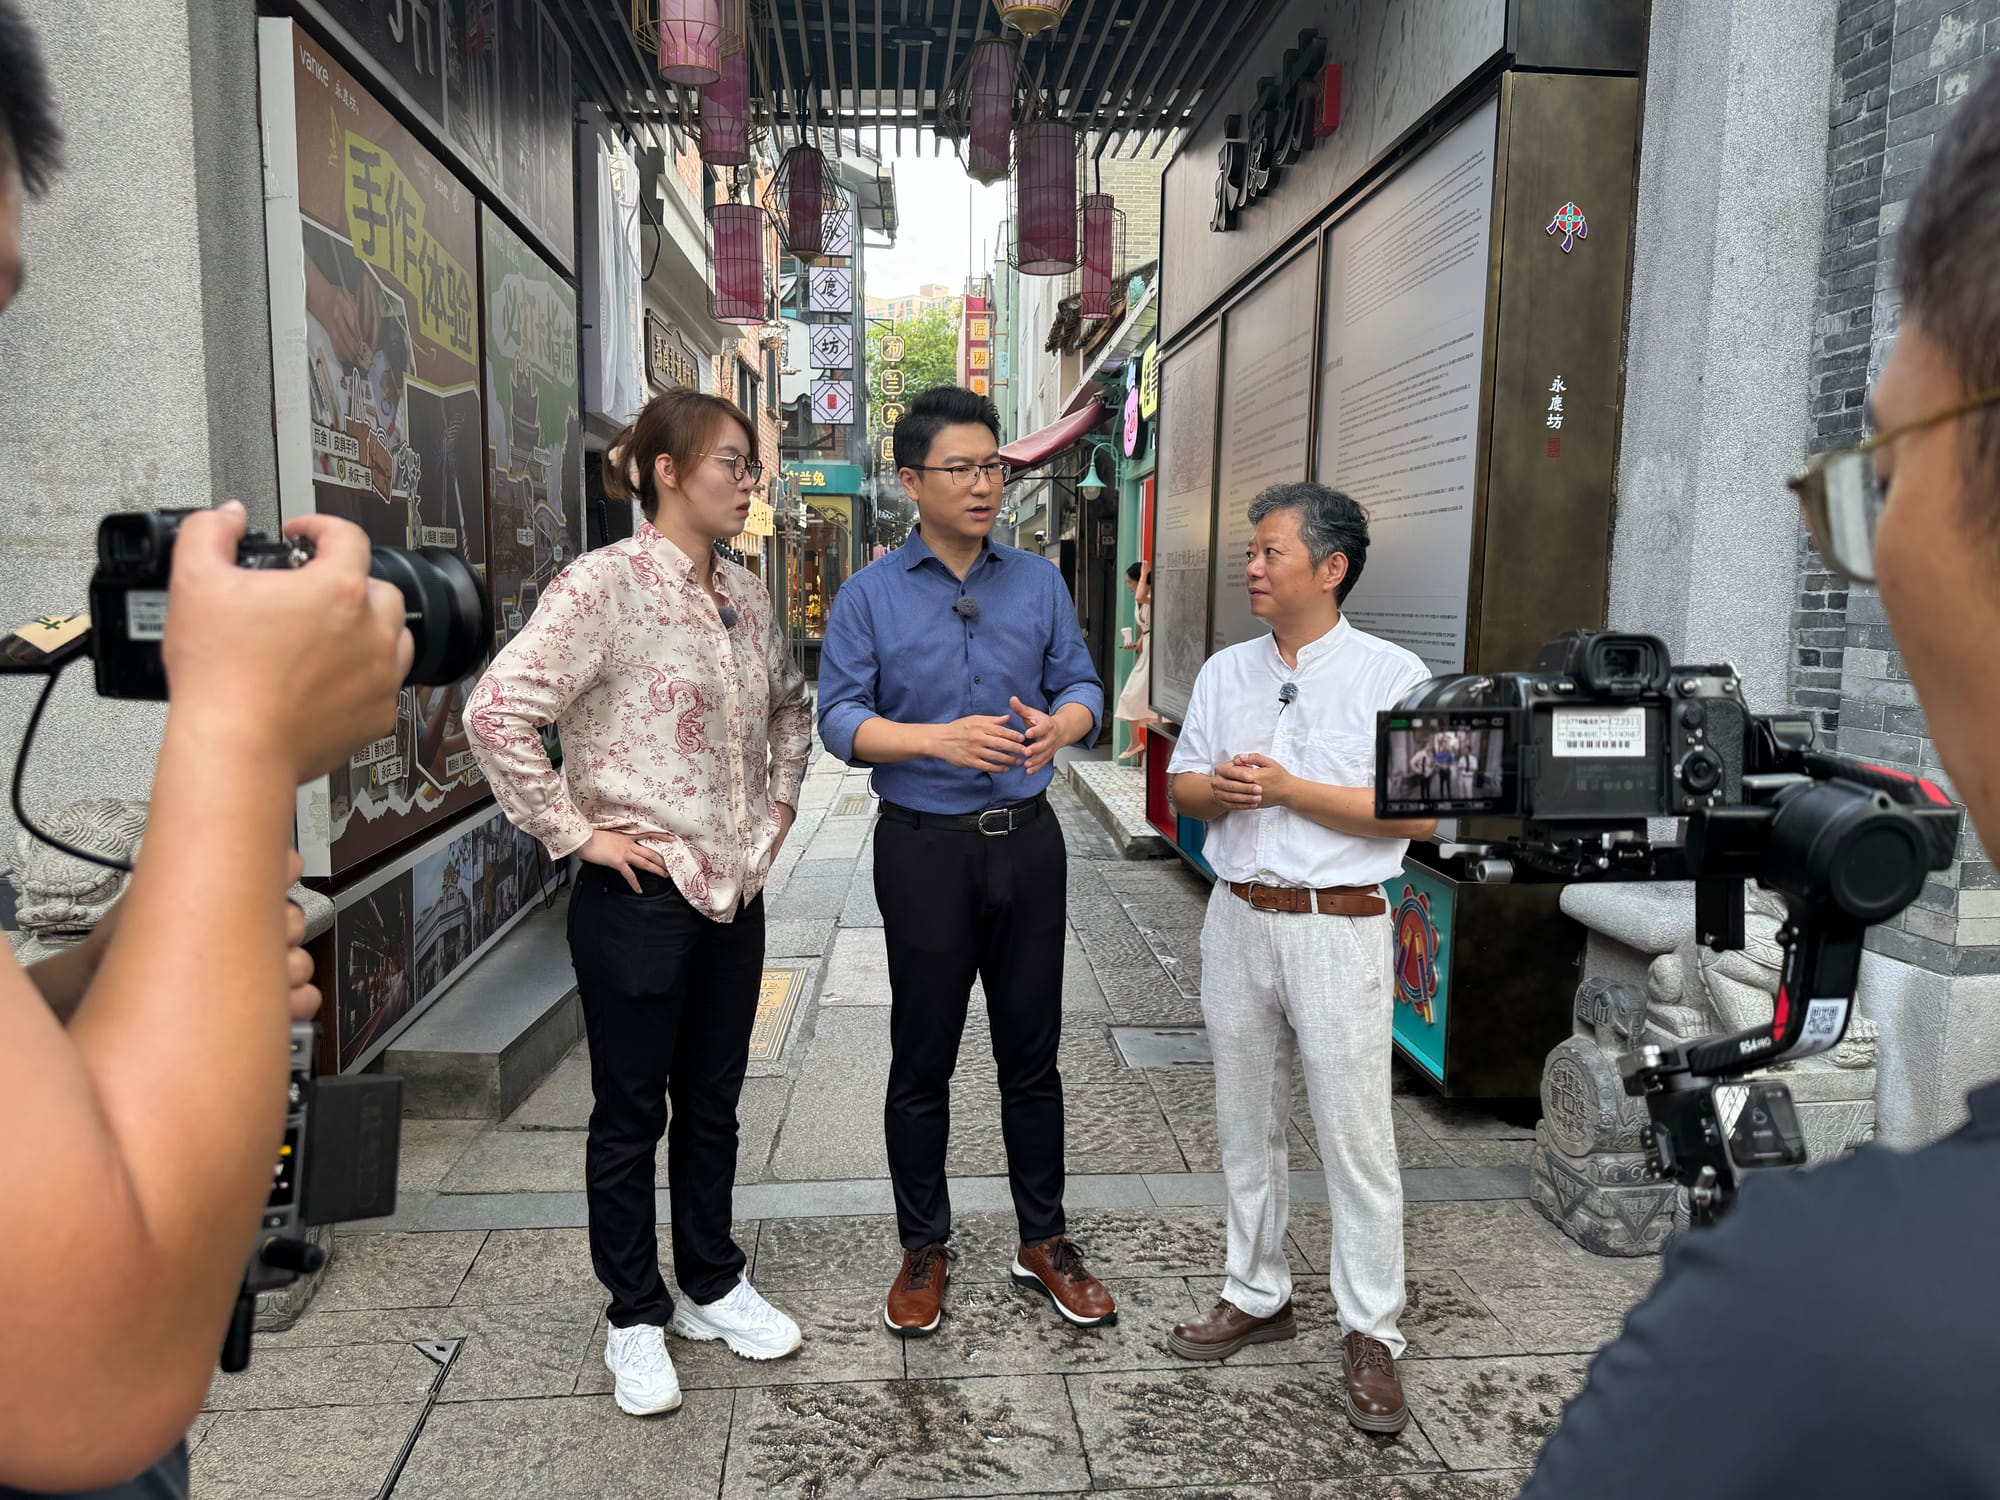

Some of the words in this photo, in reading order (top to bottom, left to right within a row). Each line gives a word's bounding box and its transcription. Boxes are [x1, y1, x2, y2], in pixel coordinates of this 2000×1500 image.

[299, 44, 329, 88] vanke
[349, 144, 473, 356] 手作体验
[348, 465, 371, 487] 永庆一巷
